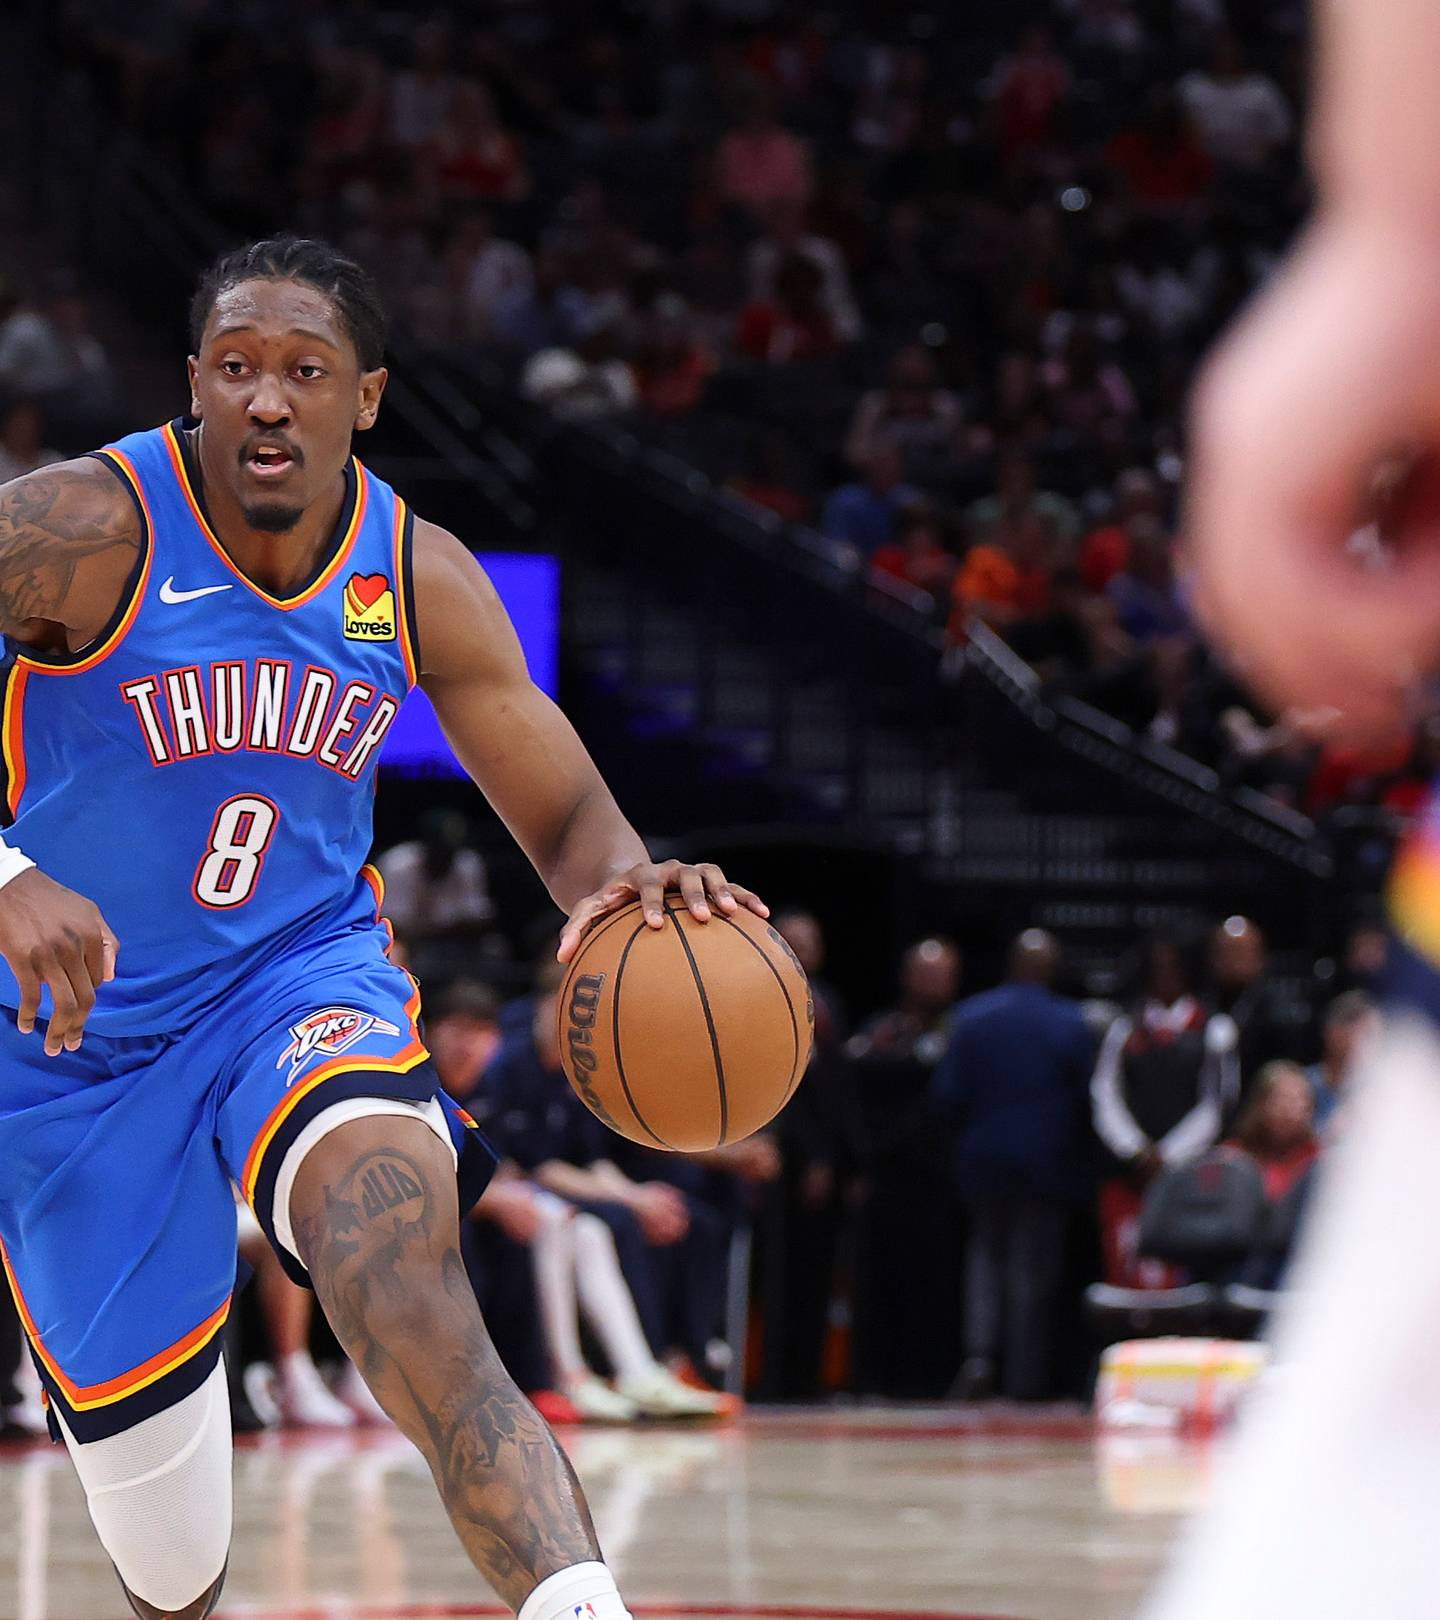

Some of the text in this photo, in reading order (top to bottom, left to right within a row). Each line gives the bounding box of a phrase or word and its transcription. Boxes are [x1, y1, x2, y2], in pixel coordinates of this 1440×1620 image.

[120, 659, 400, 781] THUNDER
[193, 794, 280, 910] 8
[297, 1015, 358, 1059] OKC
